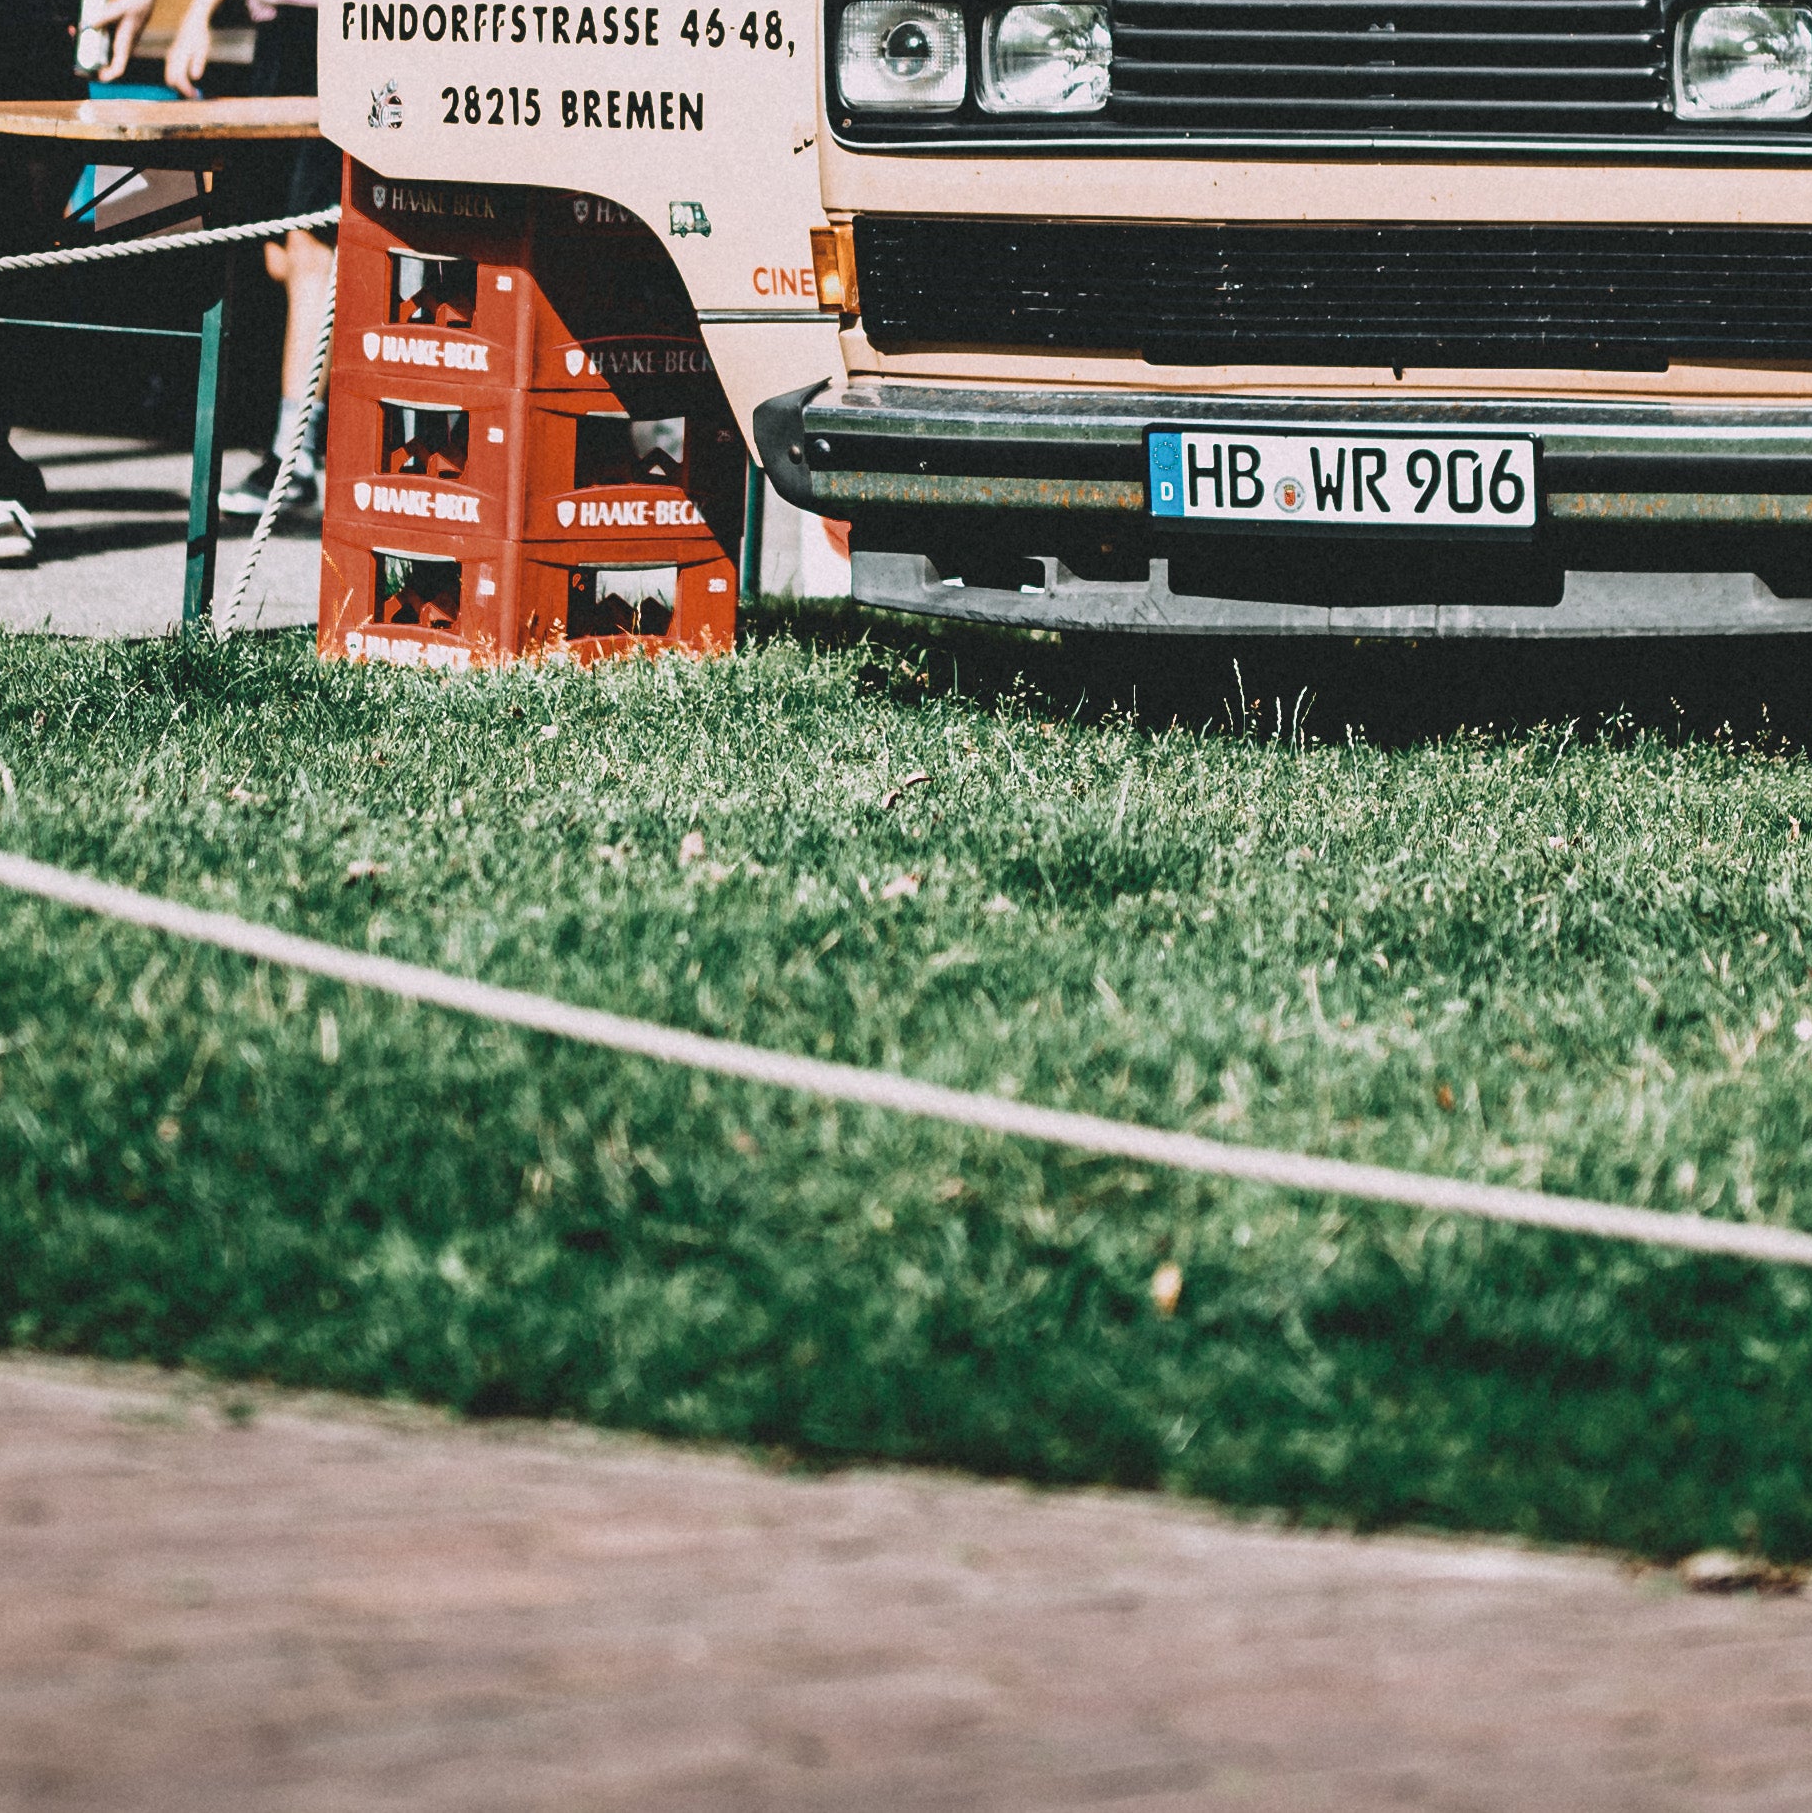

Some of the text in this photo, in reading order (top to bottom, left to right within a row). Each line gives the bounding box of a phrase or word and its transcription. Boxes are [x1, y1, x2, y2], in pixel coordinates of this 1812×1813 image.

[342, 2, 660, 47] FINDORFFSTRASSE
[441, 86, 704, 132] 28215 BREMEN
[752, 266, 816, 297] CINE
[381, 336, 490, 372] HAAKE-BECK
[1160, 443, 1526, 515] D HB WR 906
[372, 485, 481, 525] HAAKE-BECK
[580, 499, 709, 528] HAAKE-BECK
